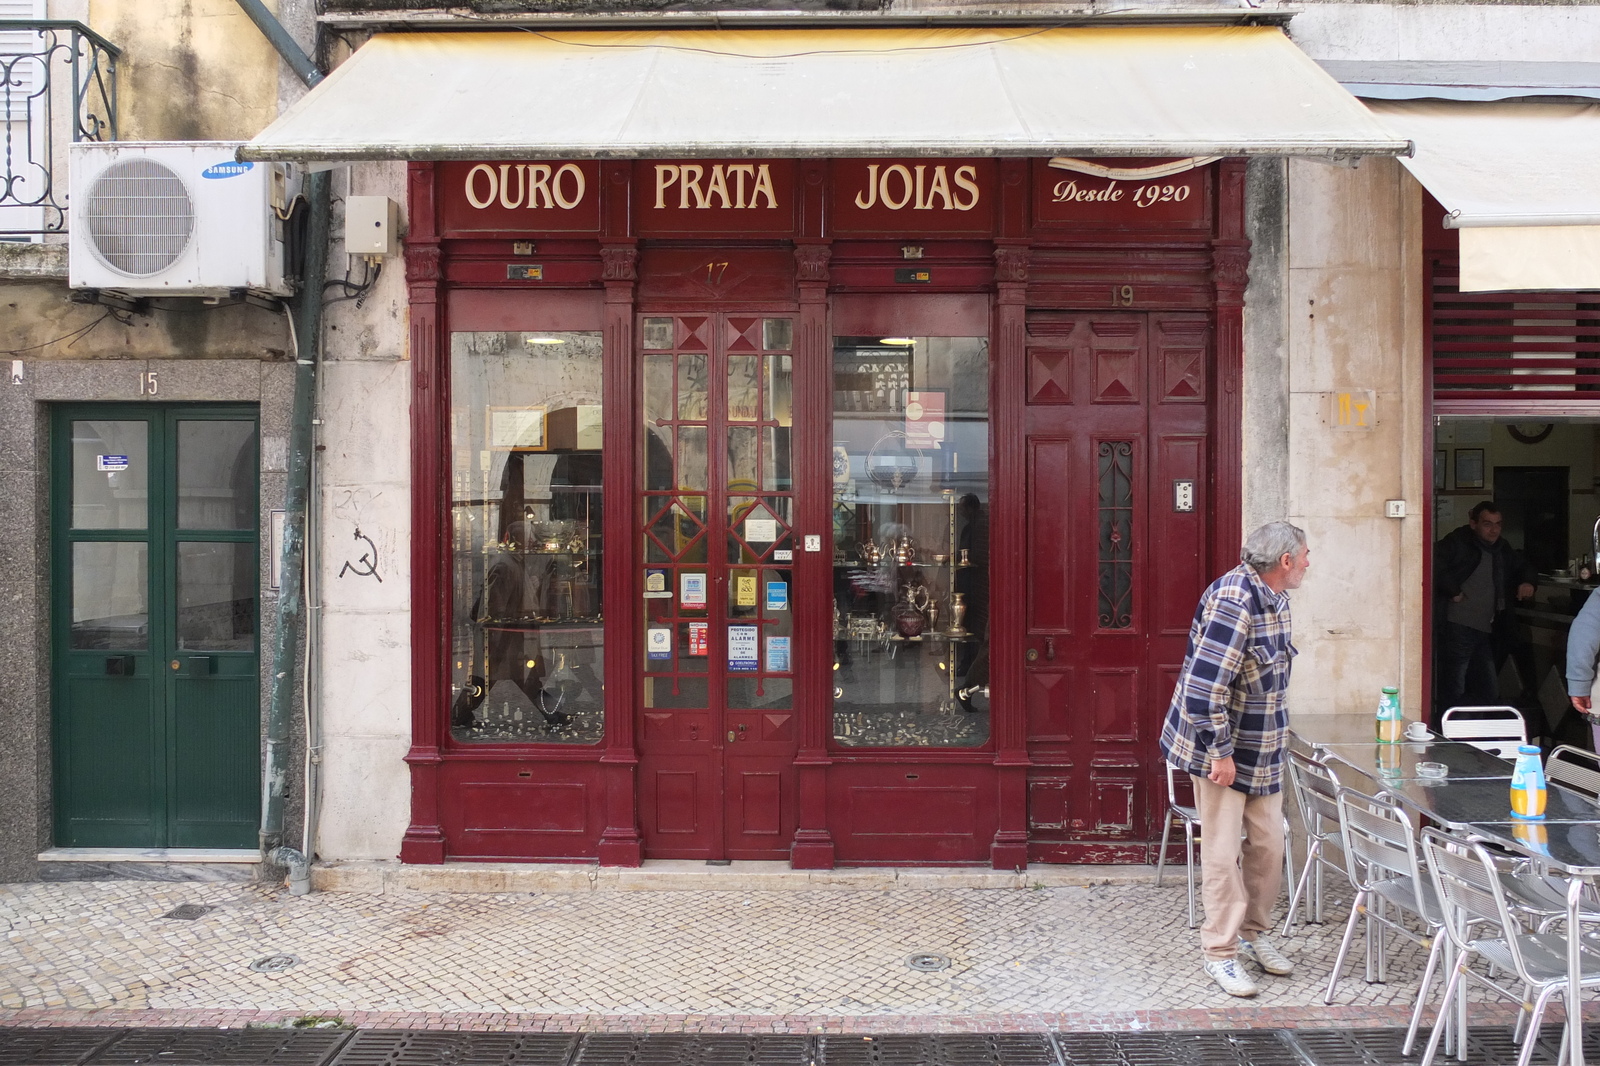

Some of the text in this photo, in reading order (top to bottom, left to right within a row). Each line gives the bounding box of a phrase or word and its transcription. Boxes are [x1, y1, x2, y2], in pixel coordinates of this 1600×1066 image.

[208, 166, 248, 174] SAMSUNG
[465, 163, 586, 209] OURO
[653, 164, 778, 209] PRATA
[854, 164, 980, 211] JOIAS
[1052, 180, 1191, 208] Desde 1920
[704, 262, 729, 284] 17
[1111, 285, 1134, 307] 19
[140, 372, 158, 395] 15
